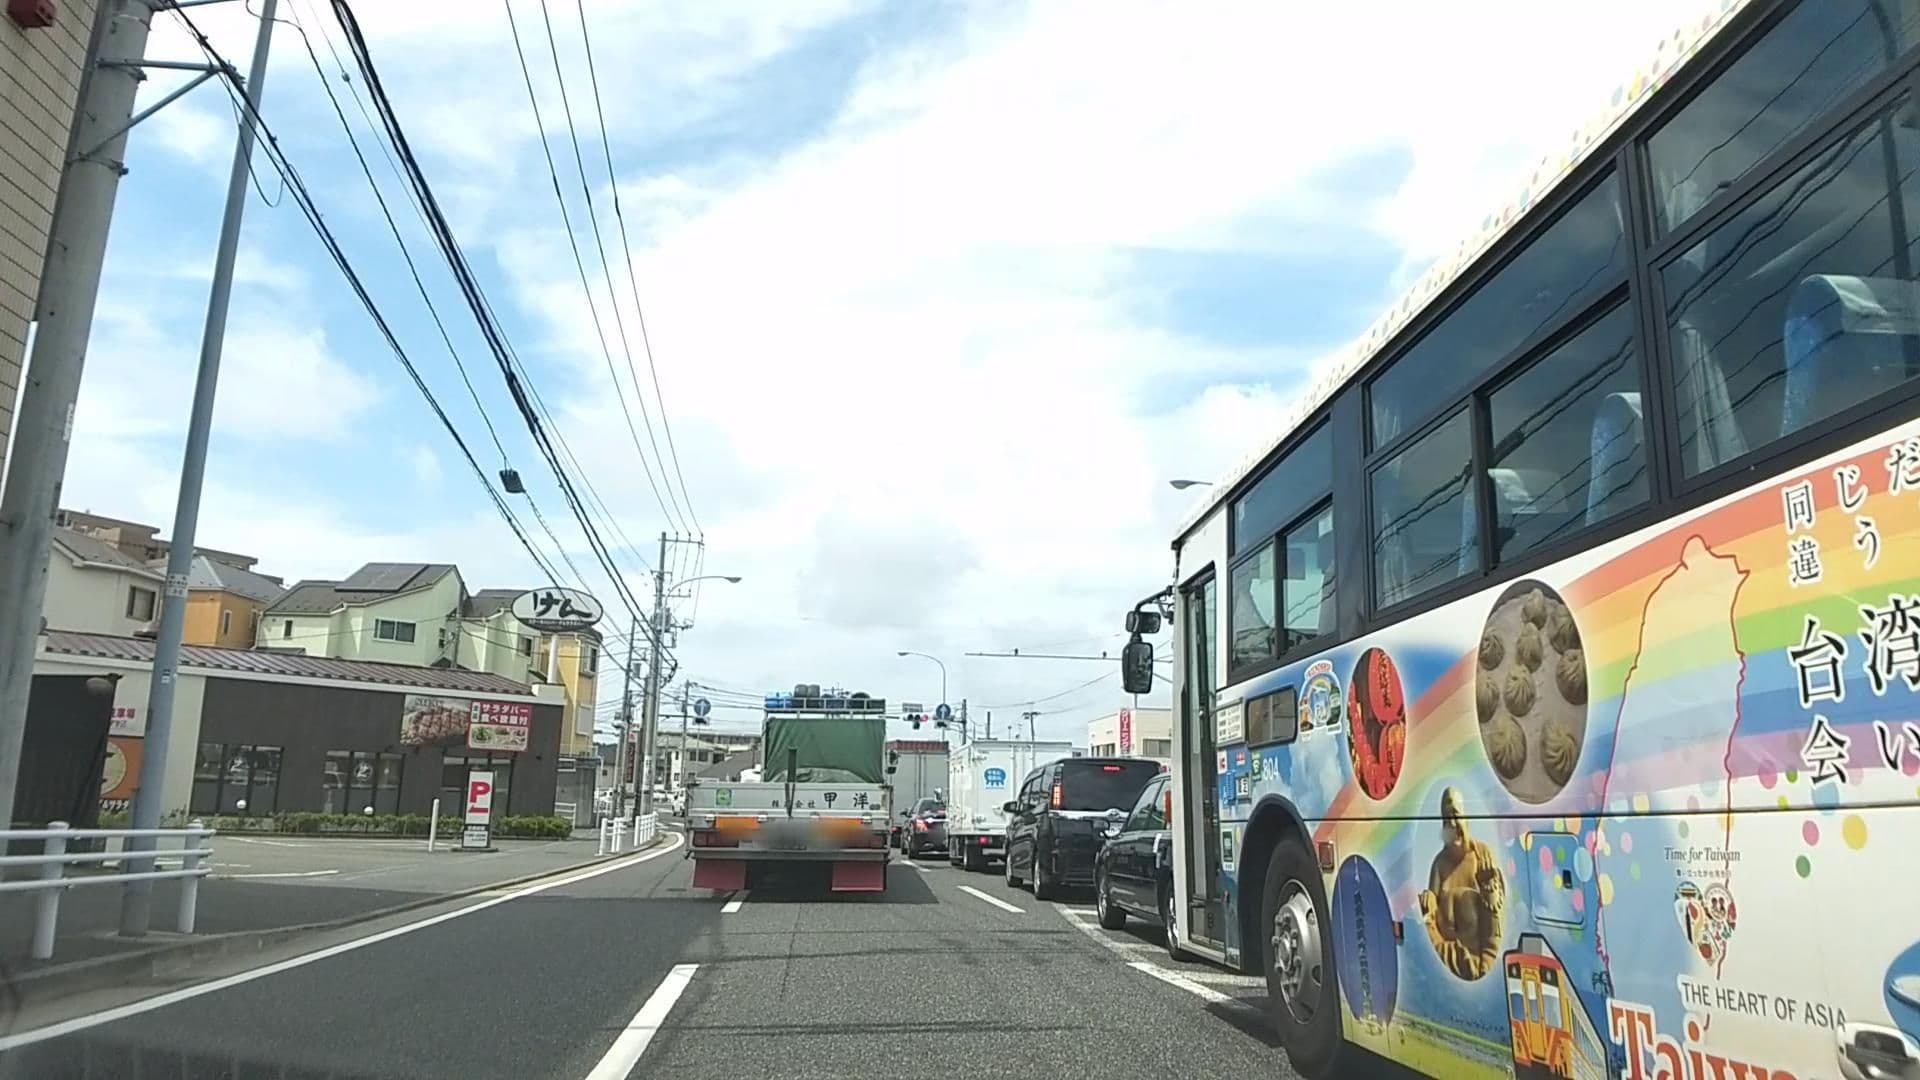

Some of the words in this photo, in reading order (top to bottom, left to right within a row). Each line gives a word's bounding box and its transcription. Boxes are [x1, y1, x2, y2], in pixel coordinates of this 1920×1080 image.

[1792, 519, 1878, 583] 違う
[533, 591, 593, 618] けん
[1790, 598, 1920, 704] 台湾
[482, 703, 528, 715] サラダバー
[1802, 719, 1920, 785] 会い
[1262, 756, 1281, 781] 804
[469, 781, 491, 803] P
[771, 799, 816, 809] 株会社
[823, 792, 869, 809] 甲洋
[1664, 847, 1686, 861] Time
[1687, 847, 1703, 863] for
[1704, 847, 1741, 861] Taiwan
[1681, 982, 1712, 1006] THE
[1715, 987, 1768, 1017] HEART
[1774, 996, 1797, 1021] OF
[1804, 1002, 1847, 1033] ASIA
